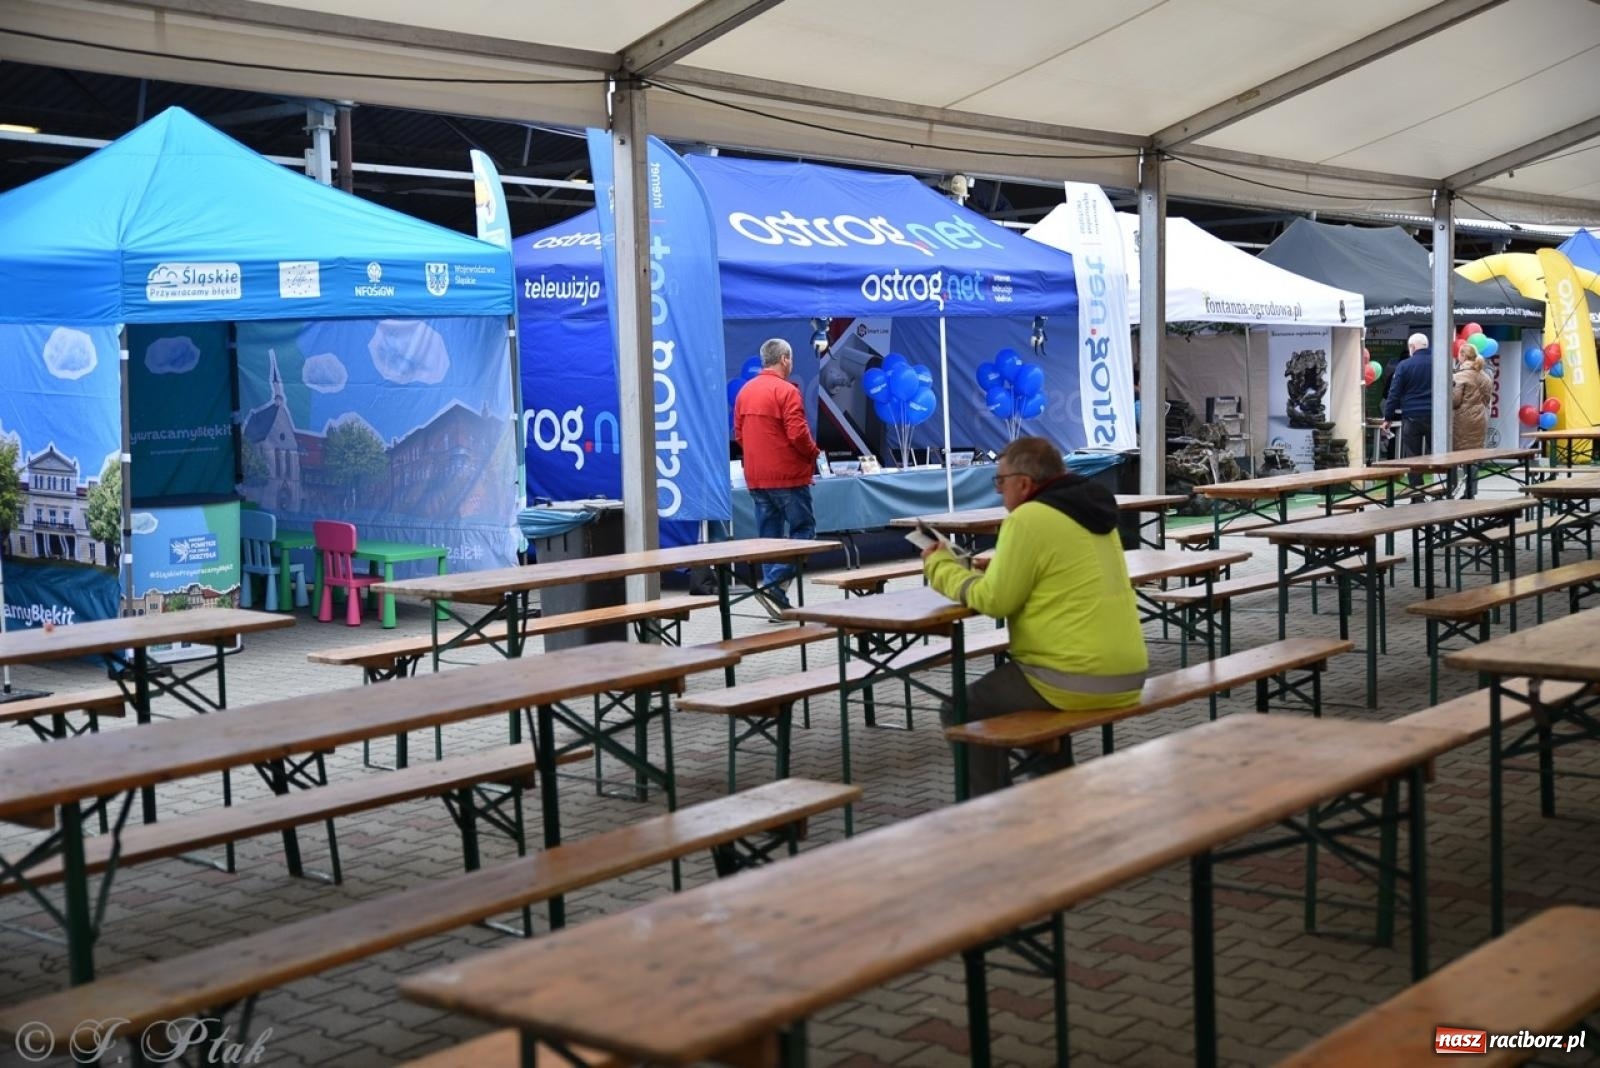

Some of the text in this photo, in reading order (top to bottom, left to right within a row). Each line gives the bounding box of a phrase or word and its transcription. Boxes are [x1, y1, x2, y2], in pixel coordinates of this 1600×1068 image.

[729, 211, 1005, 257] ostrog.net
[182, 266, 239, 286] Śląskie
[524, 274, 600, 306] telewizja
[861, 269, 985, 311] ostrog.net
[1205, 296, 1302, 321] fontanna-ogrodowa.pl
